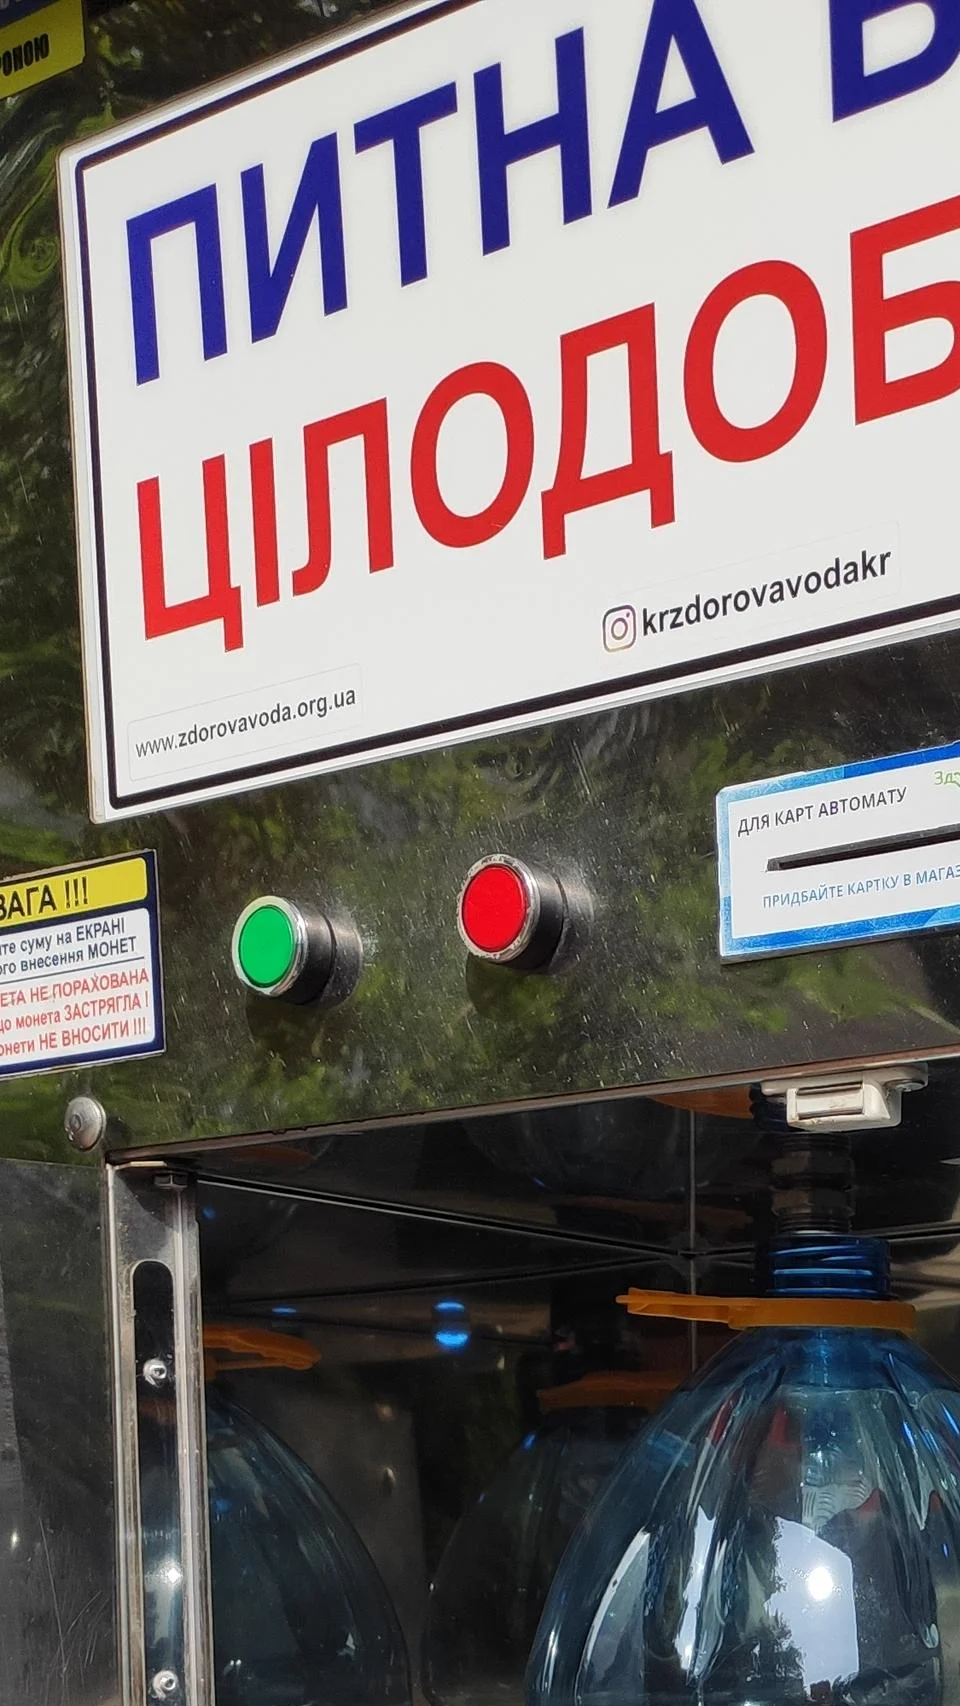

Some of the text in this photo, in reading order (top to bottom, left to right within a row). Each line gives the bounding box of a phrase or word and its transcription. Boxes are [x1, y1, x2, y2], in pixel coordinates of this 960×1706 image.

[125, 0, 756, 385] ПИТНА
[642, 549, 892, 639] krzdorovavodakr
[136, 688, 357, 758] www.zdorovavoda.org.ua
[737, 786, 907, 838] ДЛЯ КАРТ АВТОМАТУ
[763, 883, 844, 909] ПРИДБАЙТЕ
[847, 875, 900, 896] КАРТКУ
[903, 873, 912, 887] В
[20, 917, 125, 955] суму на ЕКРАНІ
[20, 935, 137, 972] внесення МОНЕТ
[31, 967, 149, 1002] НЕ ПОРАХОВАНА
[15, 993, 141, 1030] монета ЗАСТРЯГЛА
[38, 1019, 130, 1051] НЕ ВНОСИТИ
